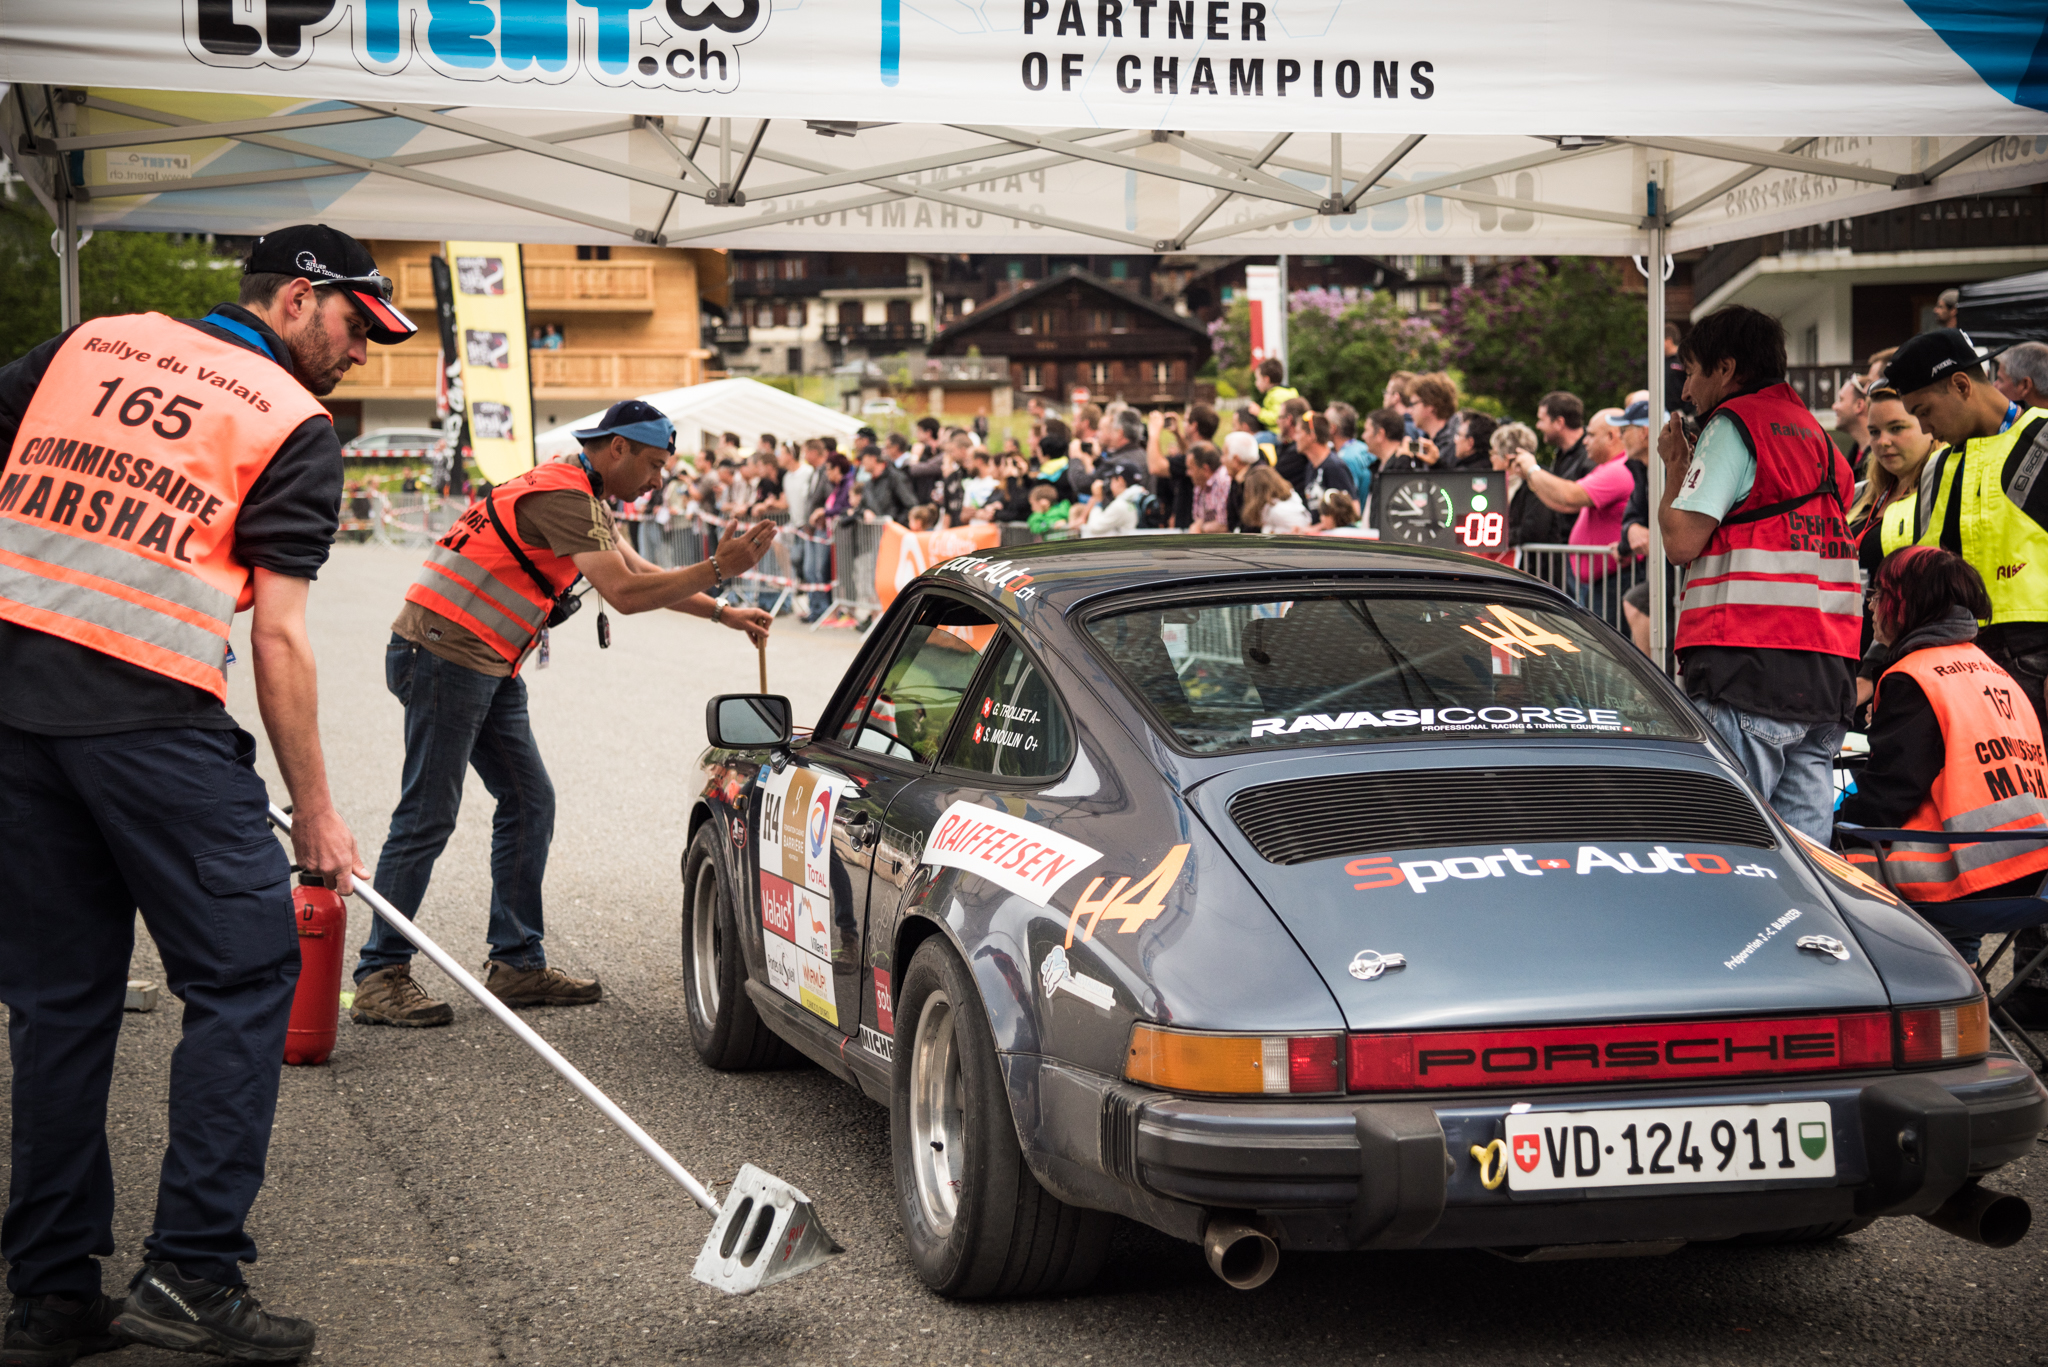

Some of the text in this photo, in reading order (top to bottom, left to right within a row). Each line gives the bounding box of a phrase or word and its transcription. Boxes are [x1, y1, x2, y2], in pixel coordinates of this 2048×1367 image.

[1023, 0, 1267, 41] PARTNER
[1021, 51, 1436, 100] OF CHAMPIONS
[83, 336, 273, 414] Rallye du Valais
[91, 376, 205, 441] 165
[1769, 422, 1813, 441] Rallye
[18, 436, 225, 527] COMMISSAIRE
[0, 472, 196, 565] MARSHAL
[1459, 604, 1582, 660] H4
[1933, 660, 1980, 677] Rallye
[1982, 685, 2017, 722] 167
[990, 728, 1024, 748] MOULIN
[1421, 724, 1489, 733] PROFESSIONAL
[1491, 723, 1526, 731] RACING
[1533, 723, 1568, 731] TUNING
[1570, 724, 1622, 732] EQUIPMENT
[763, 792, 782, 845] H4
[932, 813, 1077, 888] RAIFFEISEN
[762, 889, 789, 932] Valais
[1064, 843, 1192, 951] H4
[810, 936, 824, 956] Villars
[1418, 1032, 1836, 1077] PORSCHE
[149, 1277, 200, 1323] SALOMON
